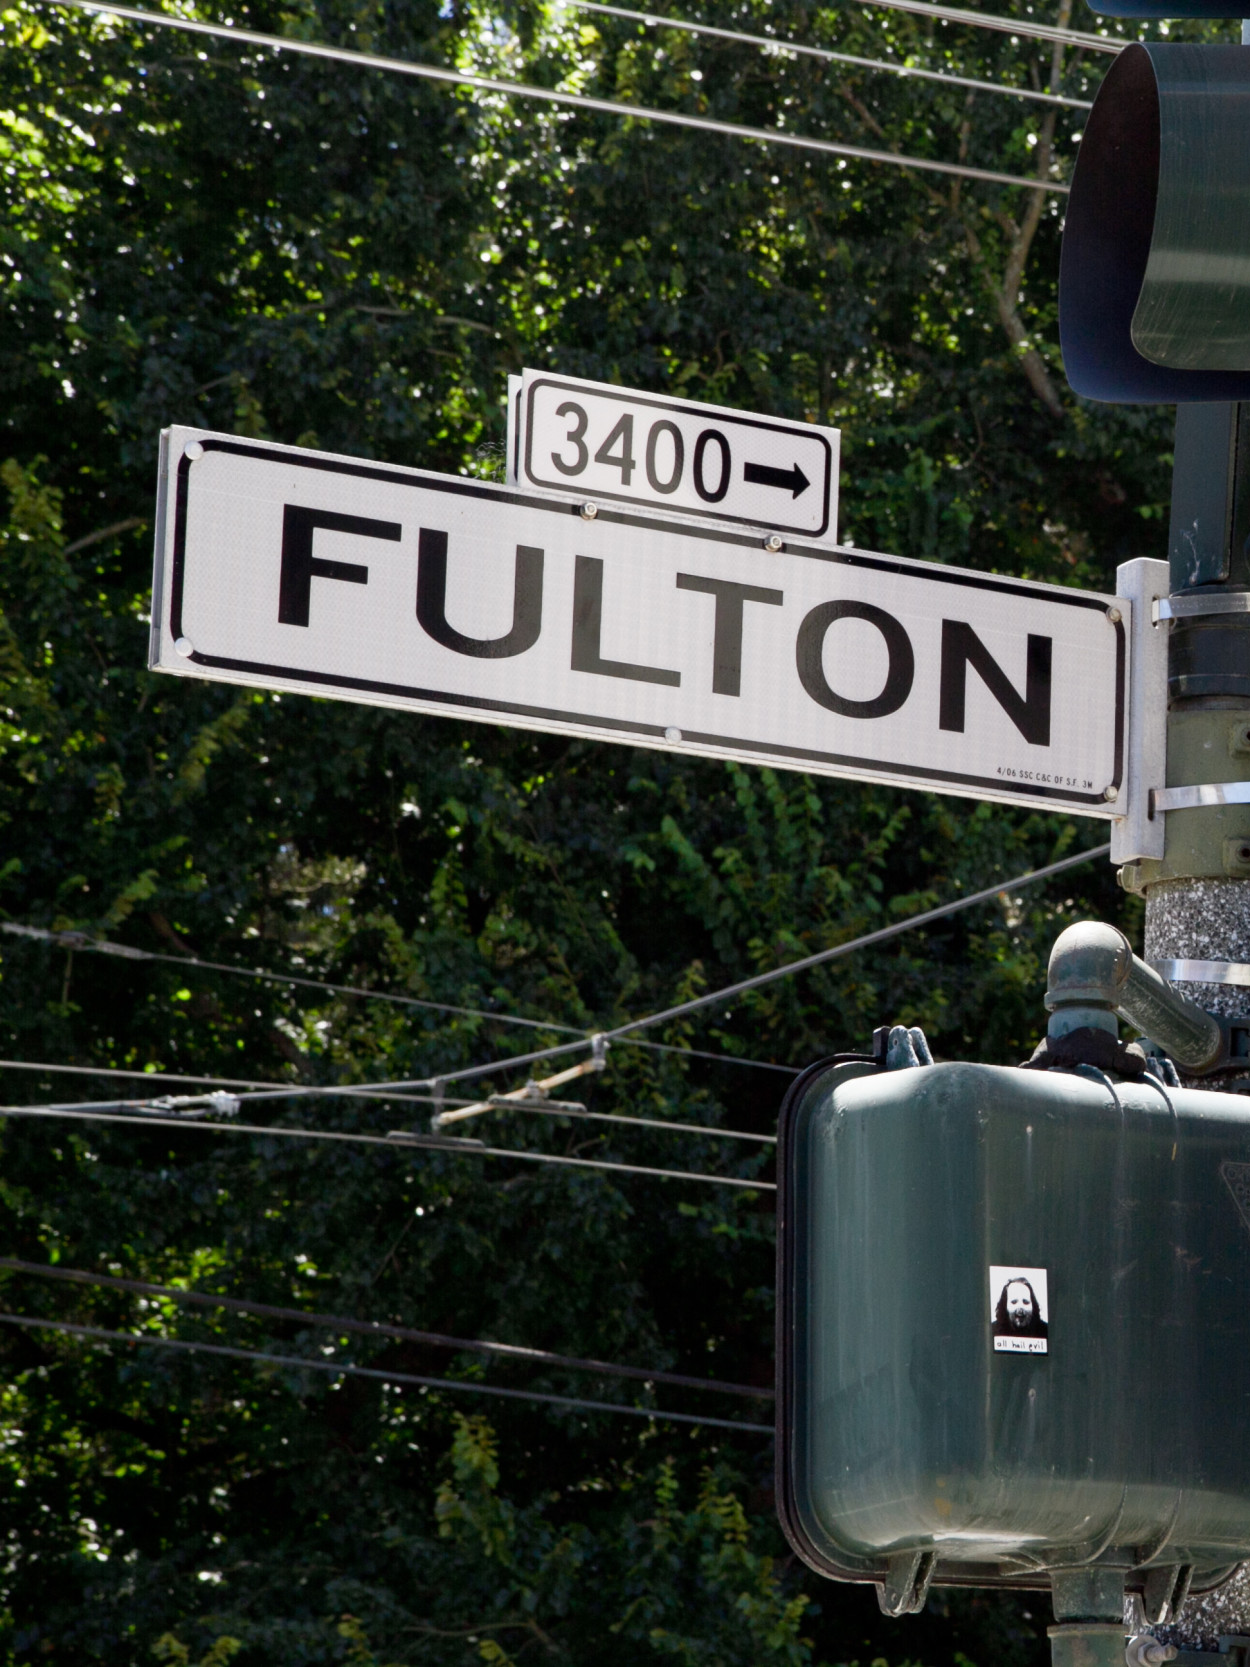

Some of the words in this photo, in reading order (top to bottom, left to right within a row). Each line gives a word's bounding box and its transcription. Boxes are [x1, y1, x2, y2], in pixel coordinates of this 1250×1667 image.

[551, 400, 732, 505] 3400
[277, 503, 1053, 747] FULTON
[997, 767, 1016, 777] 4/06
[1019, 769, 1033, 780] SSC
[1035, 772, 1052, 782] C&C
[1054, 775, 1064, 784] OF
[1082, 780, 1093, 789] 3M
[996, 1339, 1007, 1347] all
[1012, 1340, 1025, 1349] hail
